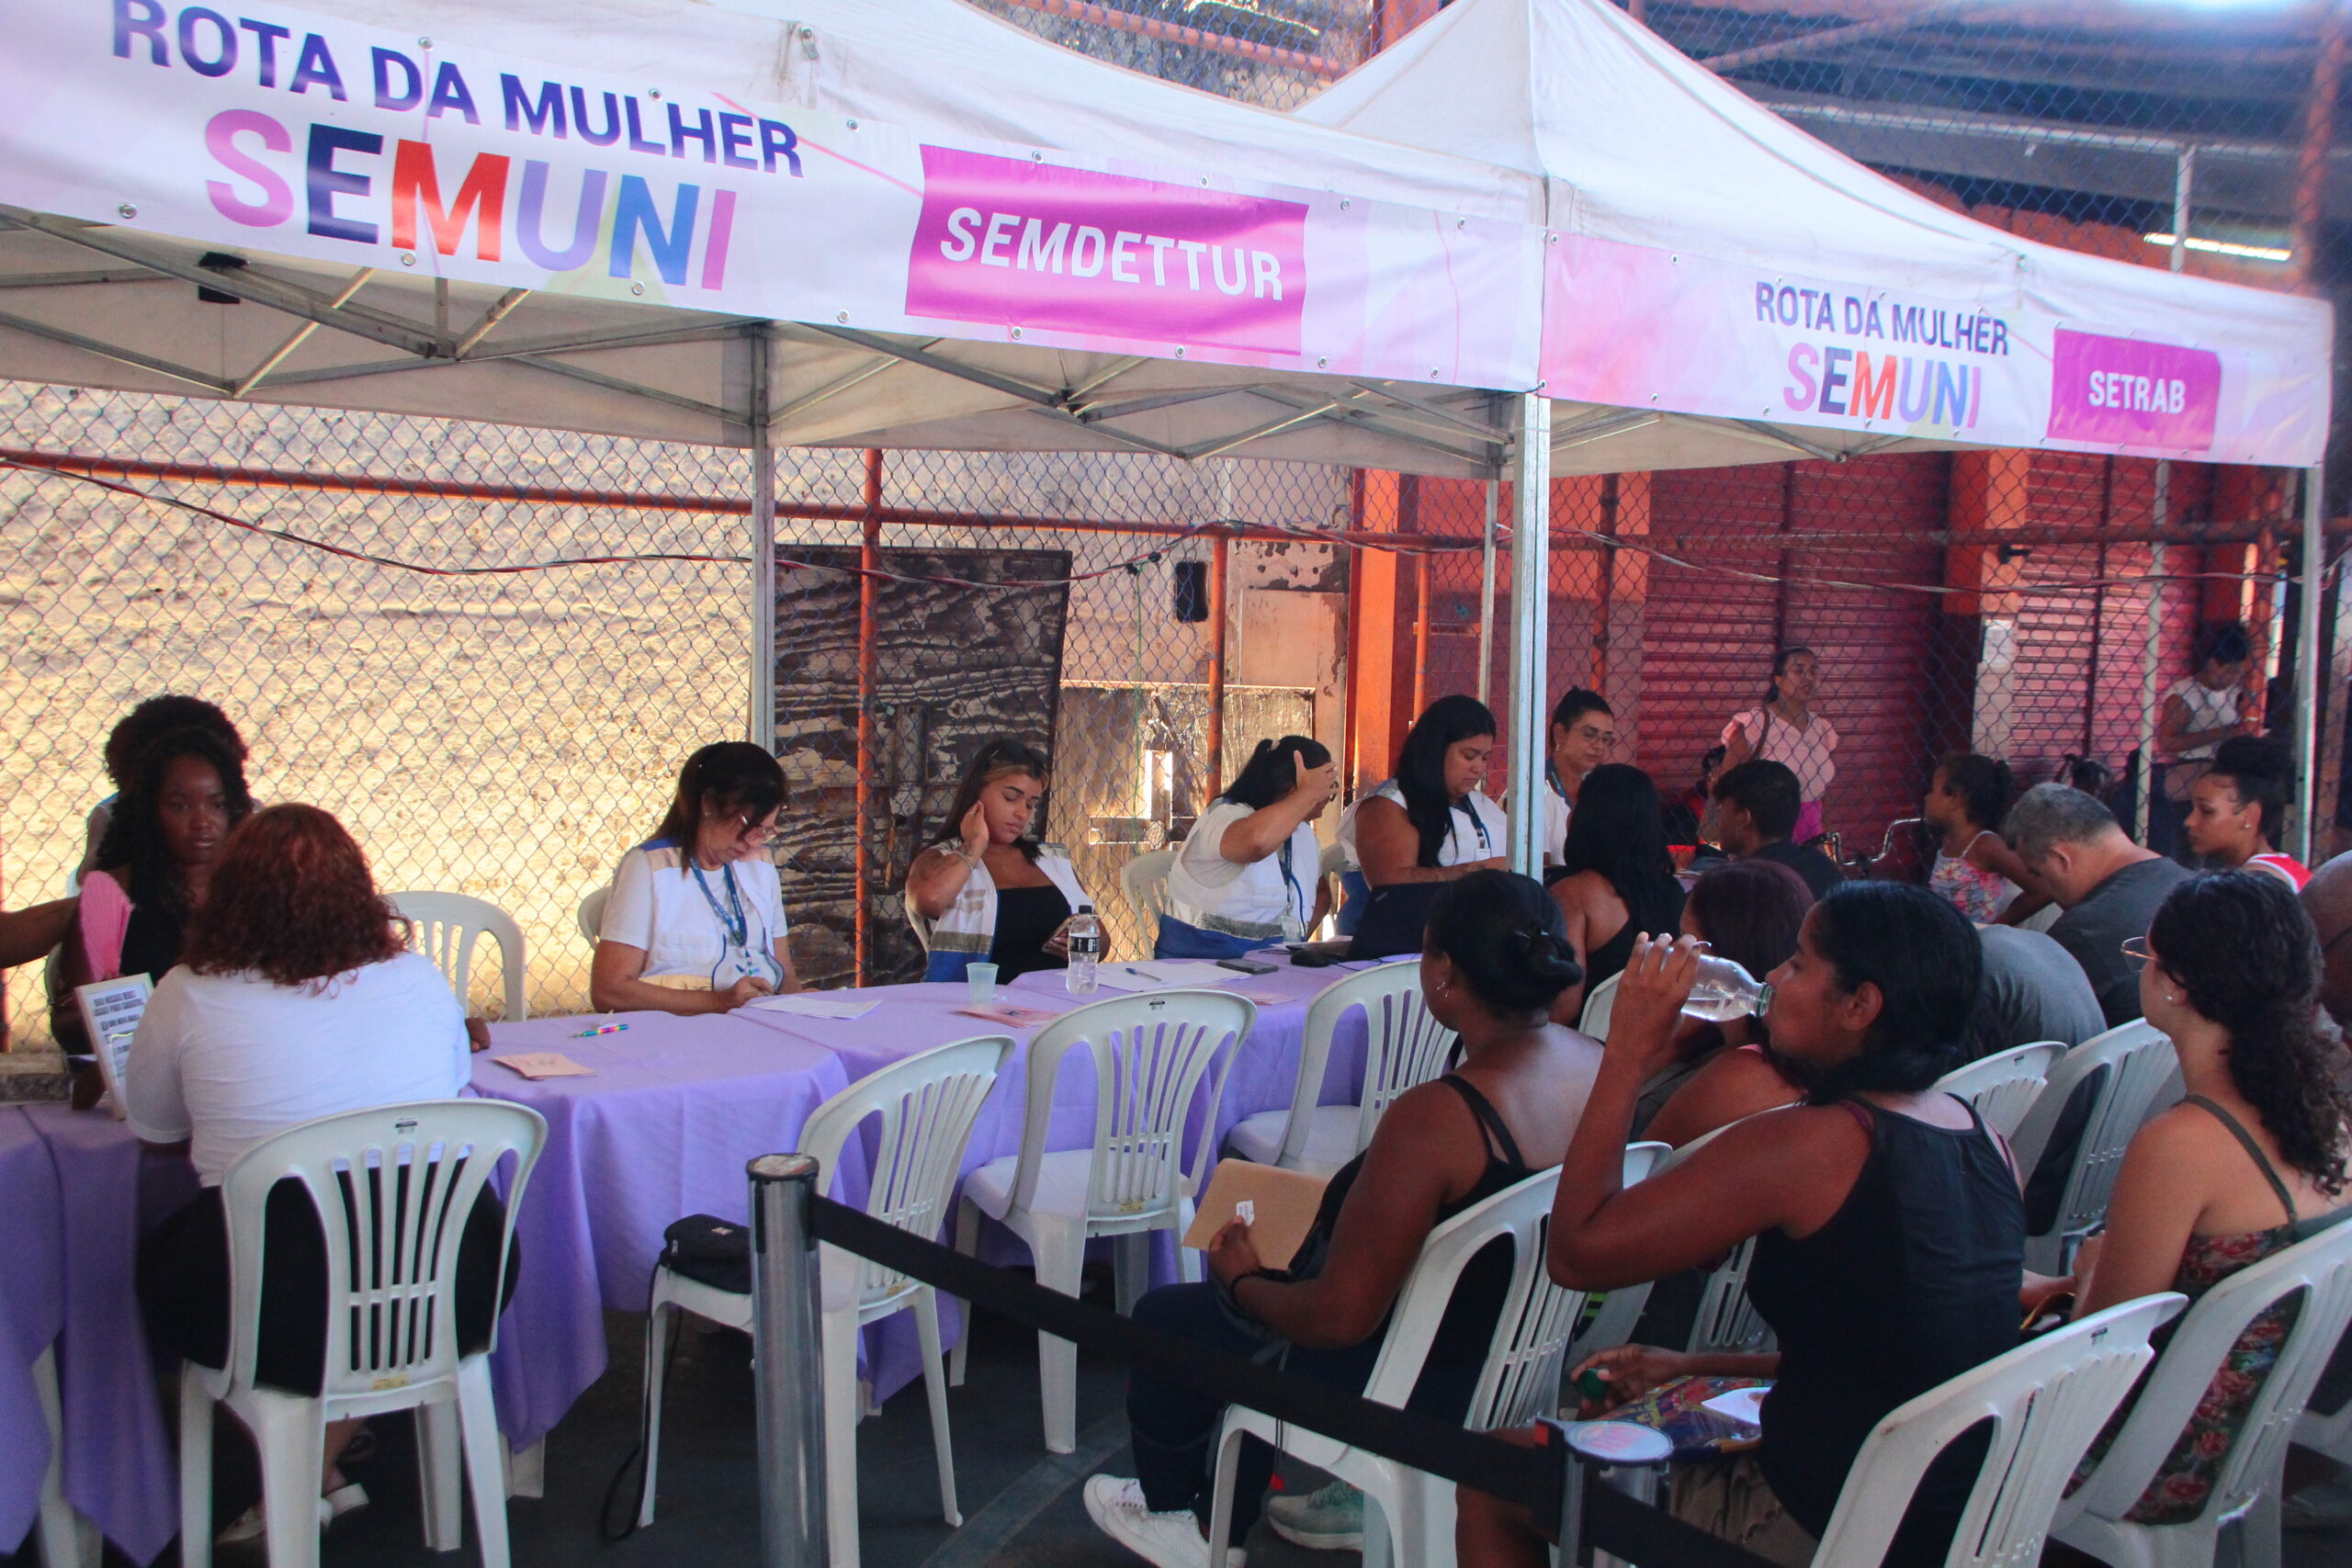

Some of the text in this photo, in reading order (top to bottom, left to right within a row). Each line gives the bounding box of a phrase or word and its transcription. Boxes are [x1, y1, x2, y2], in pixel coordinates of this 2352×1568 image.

[112, 0, 804, 177] ROTA DA MULHER
[205, 109, 736, 290] SEMUNI
[941, 208, 1283, 300] SEMDETTUR
[1756, 282, 2009, 355] ROTA DA MULHER
[1782, 343, 1981, 428] SEMUNI
[2088, 370, 2187, 415] SETRAB
